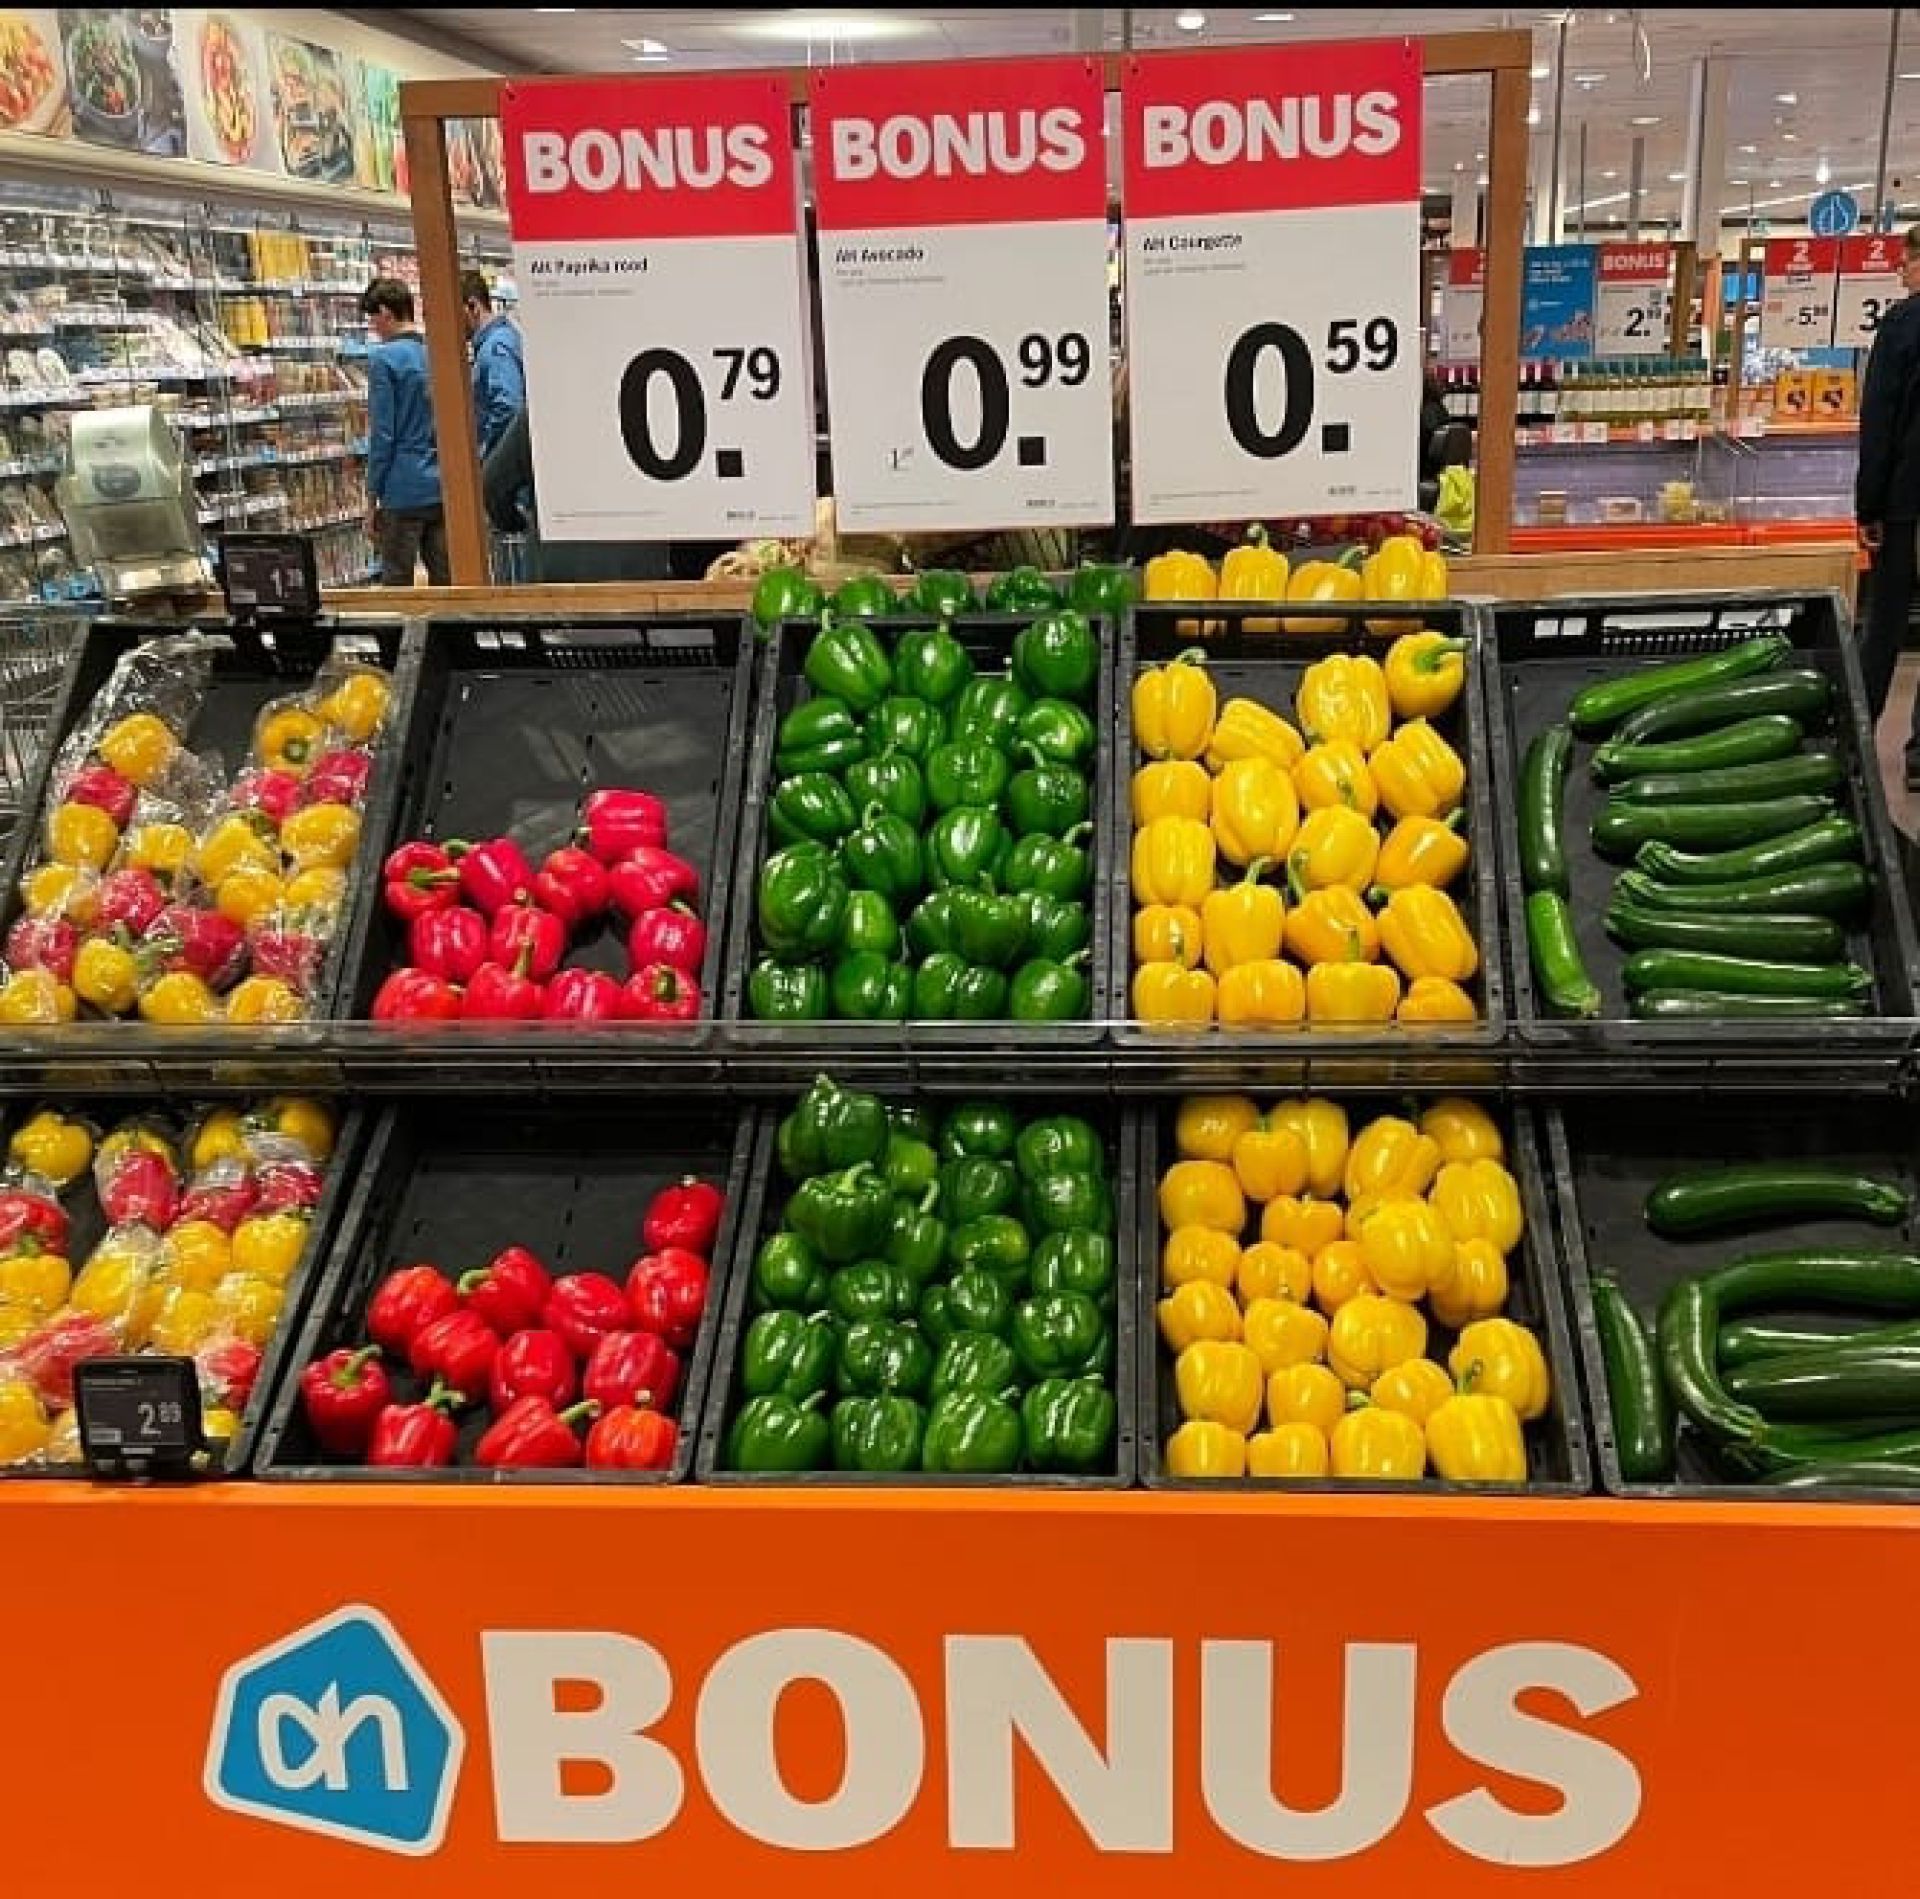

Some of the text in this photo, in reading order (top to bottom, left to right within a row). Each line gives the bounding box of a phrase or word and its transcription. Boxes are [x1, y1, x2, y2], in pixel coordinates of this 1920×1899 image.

[522, 124, 774, 193] BONUS
[830, 108, 1085, 180] BONUS
[1143, 91, 1401, 168] BONUS
[1602, 252, 1666, 271] BONUS
[481, 1627, 1643, 1868] BONUS
